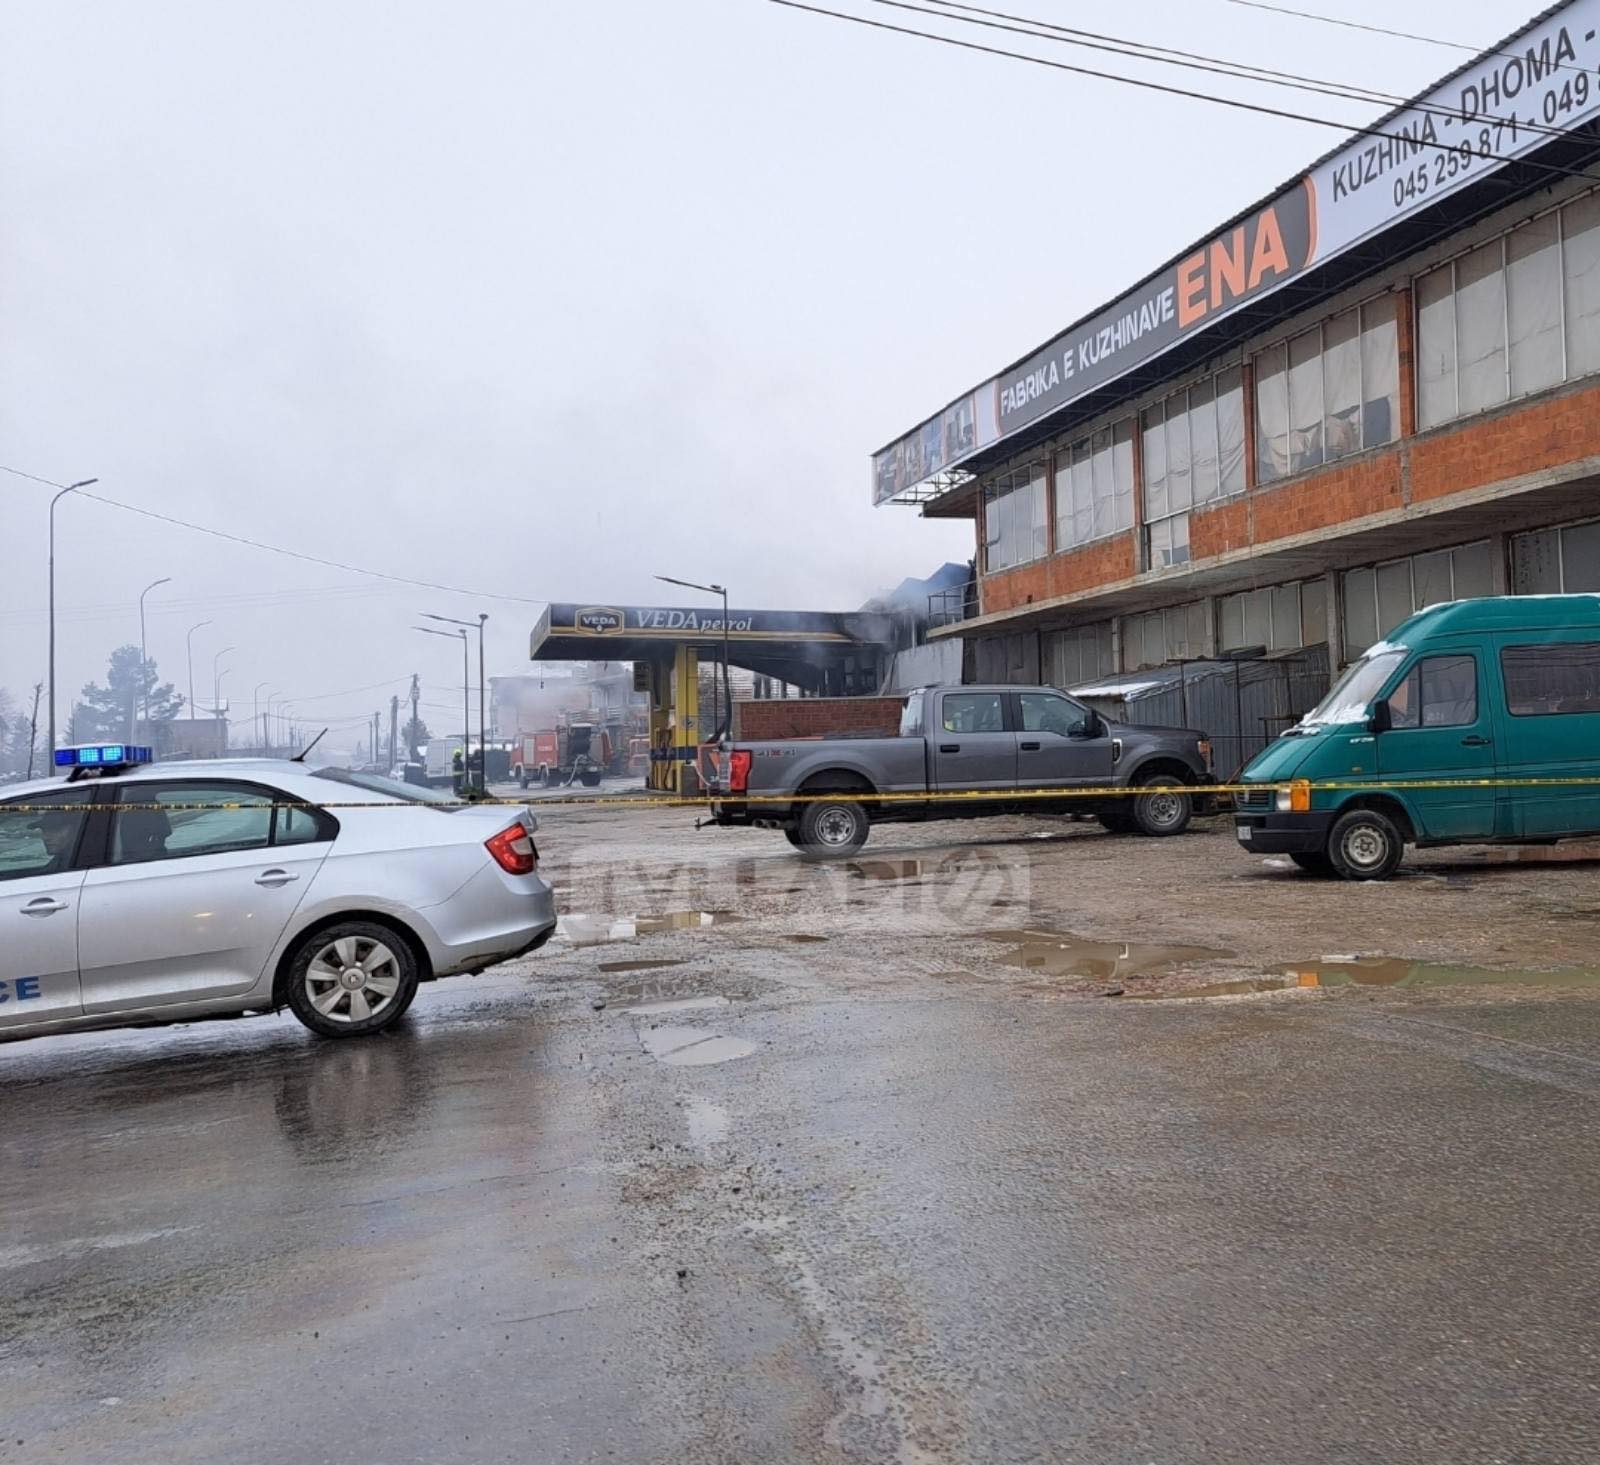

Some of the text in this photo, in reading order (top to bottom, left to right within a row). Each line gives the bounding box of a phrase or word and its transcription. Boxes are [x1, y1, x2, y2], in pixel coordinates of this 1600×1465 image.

[1333, 111, 1437, 202] KUZHINA
[1461, 26, 1576, 125] DHOMA
[1394, 173, 1428, 207] 045
[1435, 140, 1471, 186] 259
[1479, 112, 1518, 159] 871
[1543, 72, 1589, 125] 049
[1001, 208, 1289, 417] FABRIKA E KUZHINAVE ENA
[583, 616, 617, 627] VEDA
[636, 609, 700, 630] VEDA
